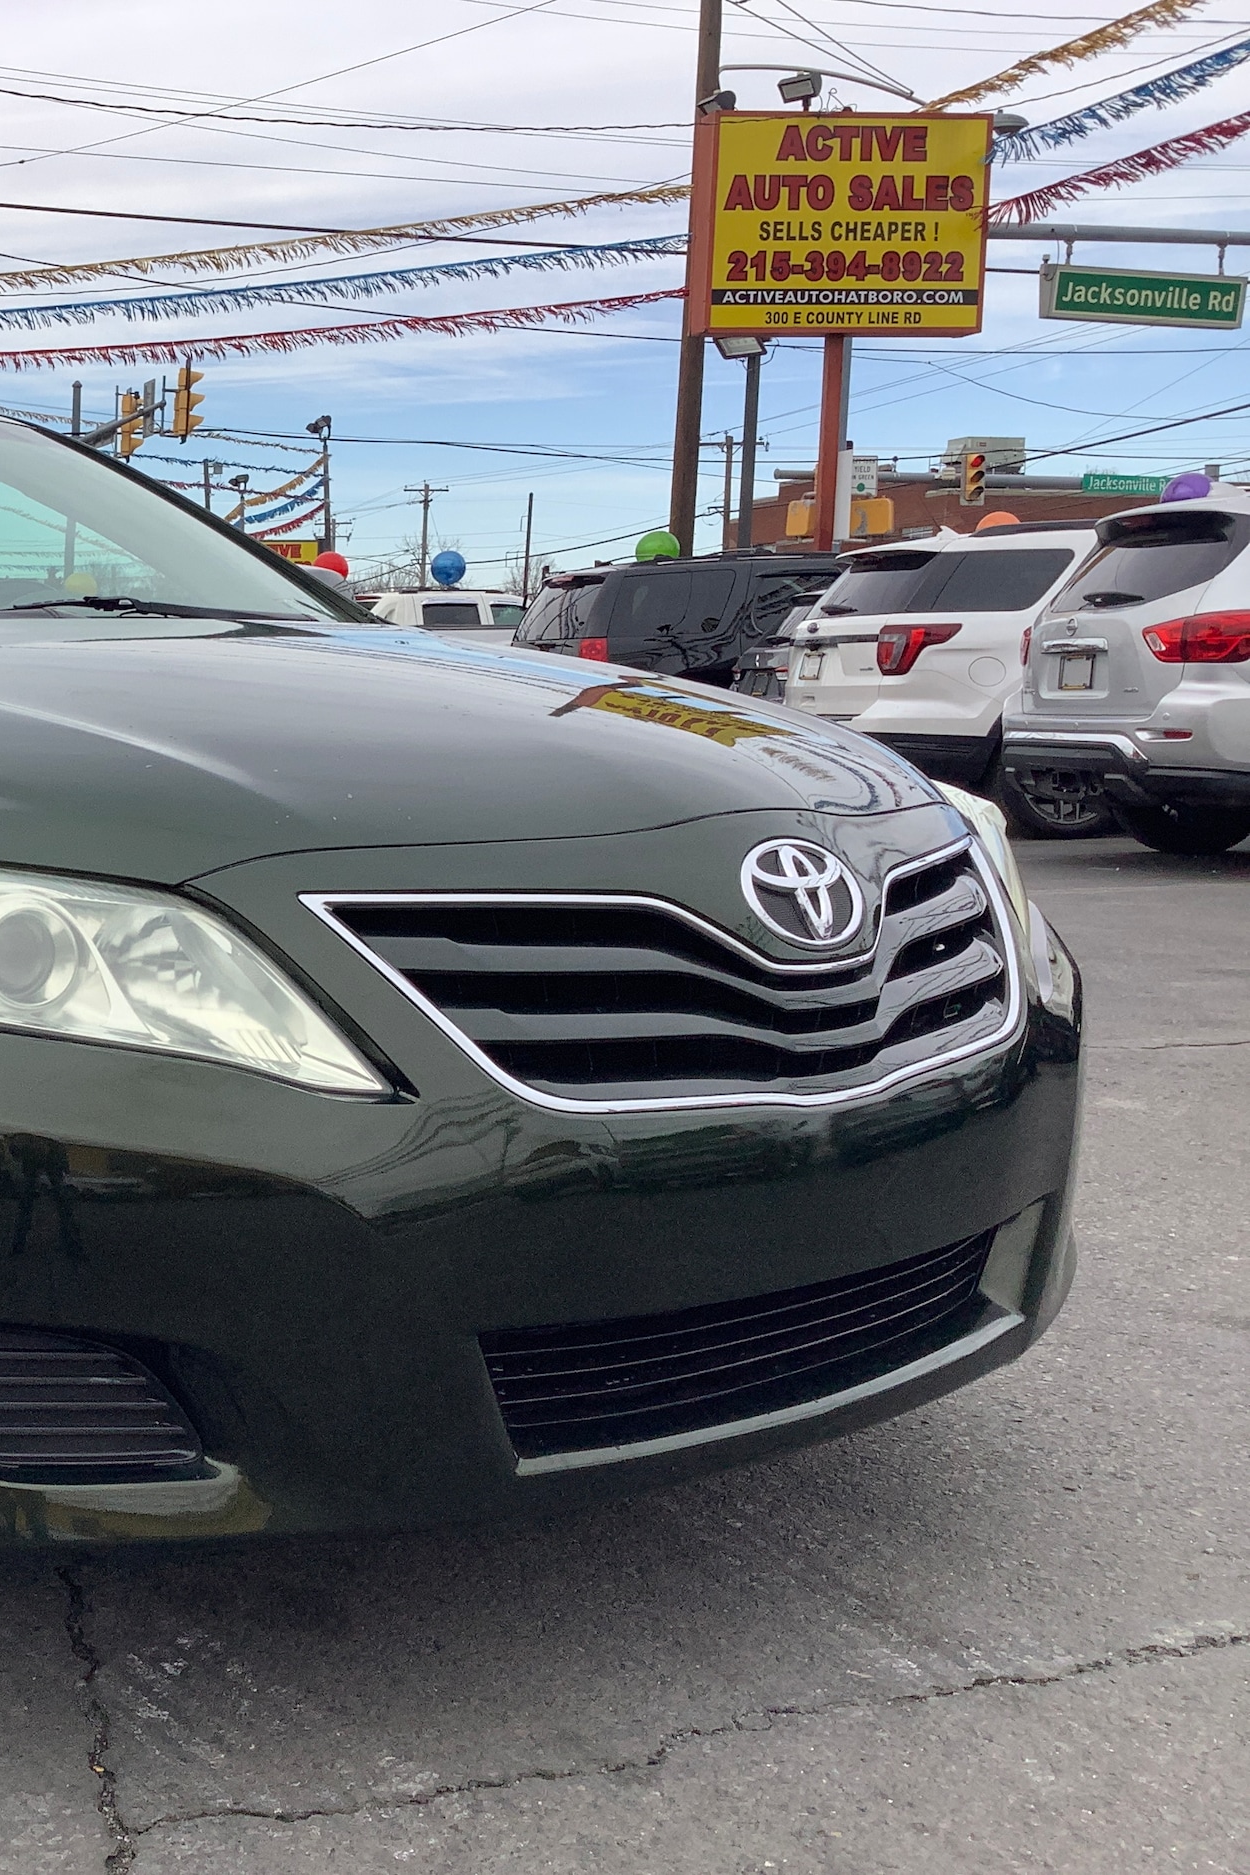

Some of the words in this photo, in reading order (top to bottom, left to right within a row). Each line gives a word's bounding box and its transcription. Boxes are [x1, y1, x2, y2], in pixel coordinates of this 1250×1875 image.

[776, 125, 928, 162] ACTIVE
[724, 174, 835, 211] AUTO
[848, 175, 974, 212] SALES
[759, 221, 823, 242] SELLS
[830, 221, 926, 242] CHEAPER
[726, 250, 964, 282] 215-394-8922
[722, 290, 964, 305] ACTIVEAUTOHATBORO.COM
[1062, 281, 1201, 310] Jacksonville
[1208, 291, 1235, 312] Rd
[765, 312, 788, 325] 300
[793, 312, 802, 325] E
[806, 312, 863, 325] COUNTY
[868, 312, 900, 325] LINE
[903, 312, 922, 325] RD
[1088, 476, 1156, 491] Jacksonville
